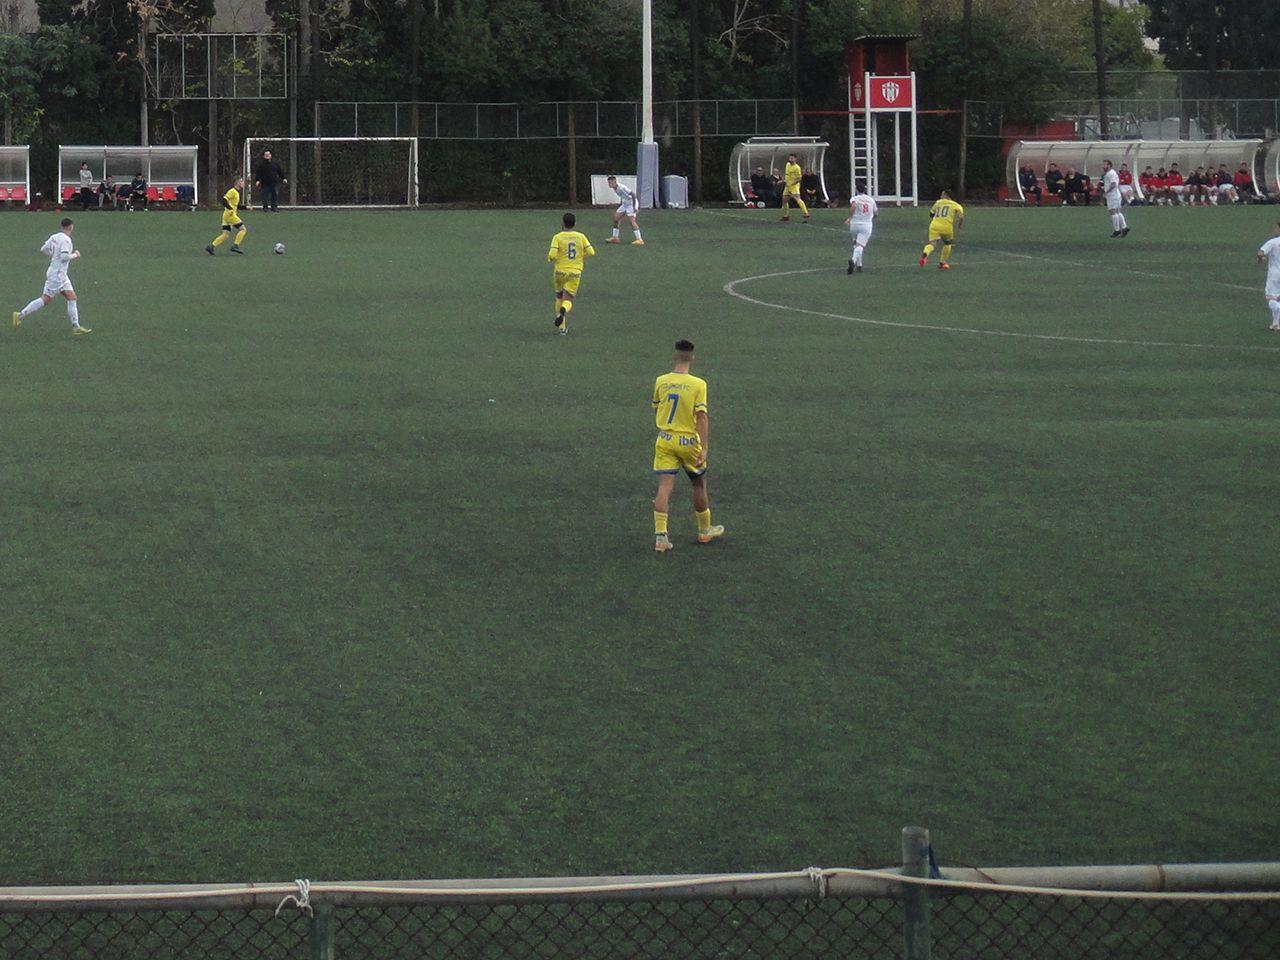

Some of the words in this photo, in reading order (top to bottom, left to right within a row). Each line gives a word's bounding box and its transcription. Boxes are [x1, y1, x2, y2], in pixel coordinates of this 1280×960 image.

[935, 205, 950, 218] 10
[568, 242, 577, 259] 6
[667, 393, 680, 425] 7
